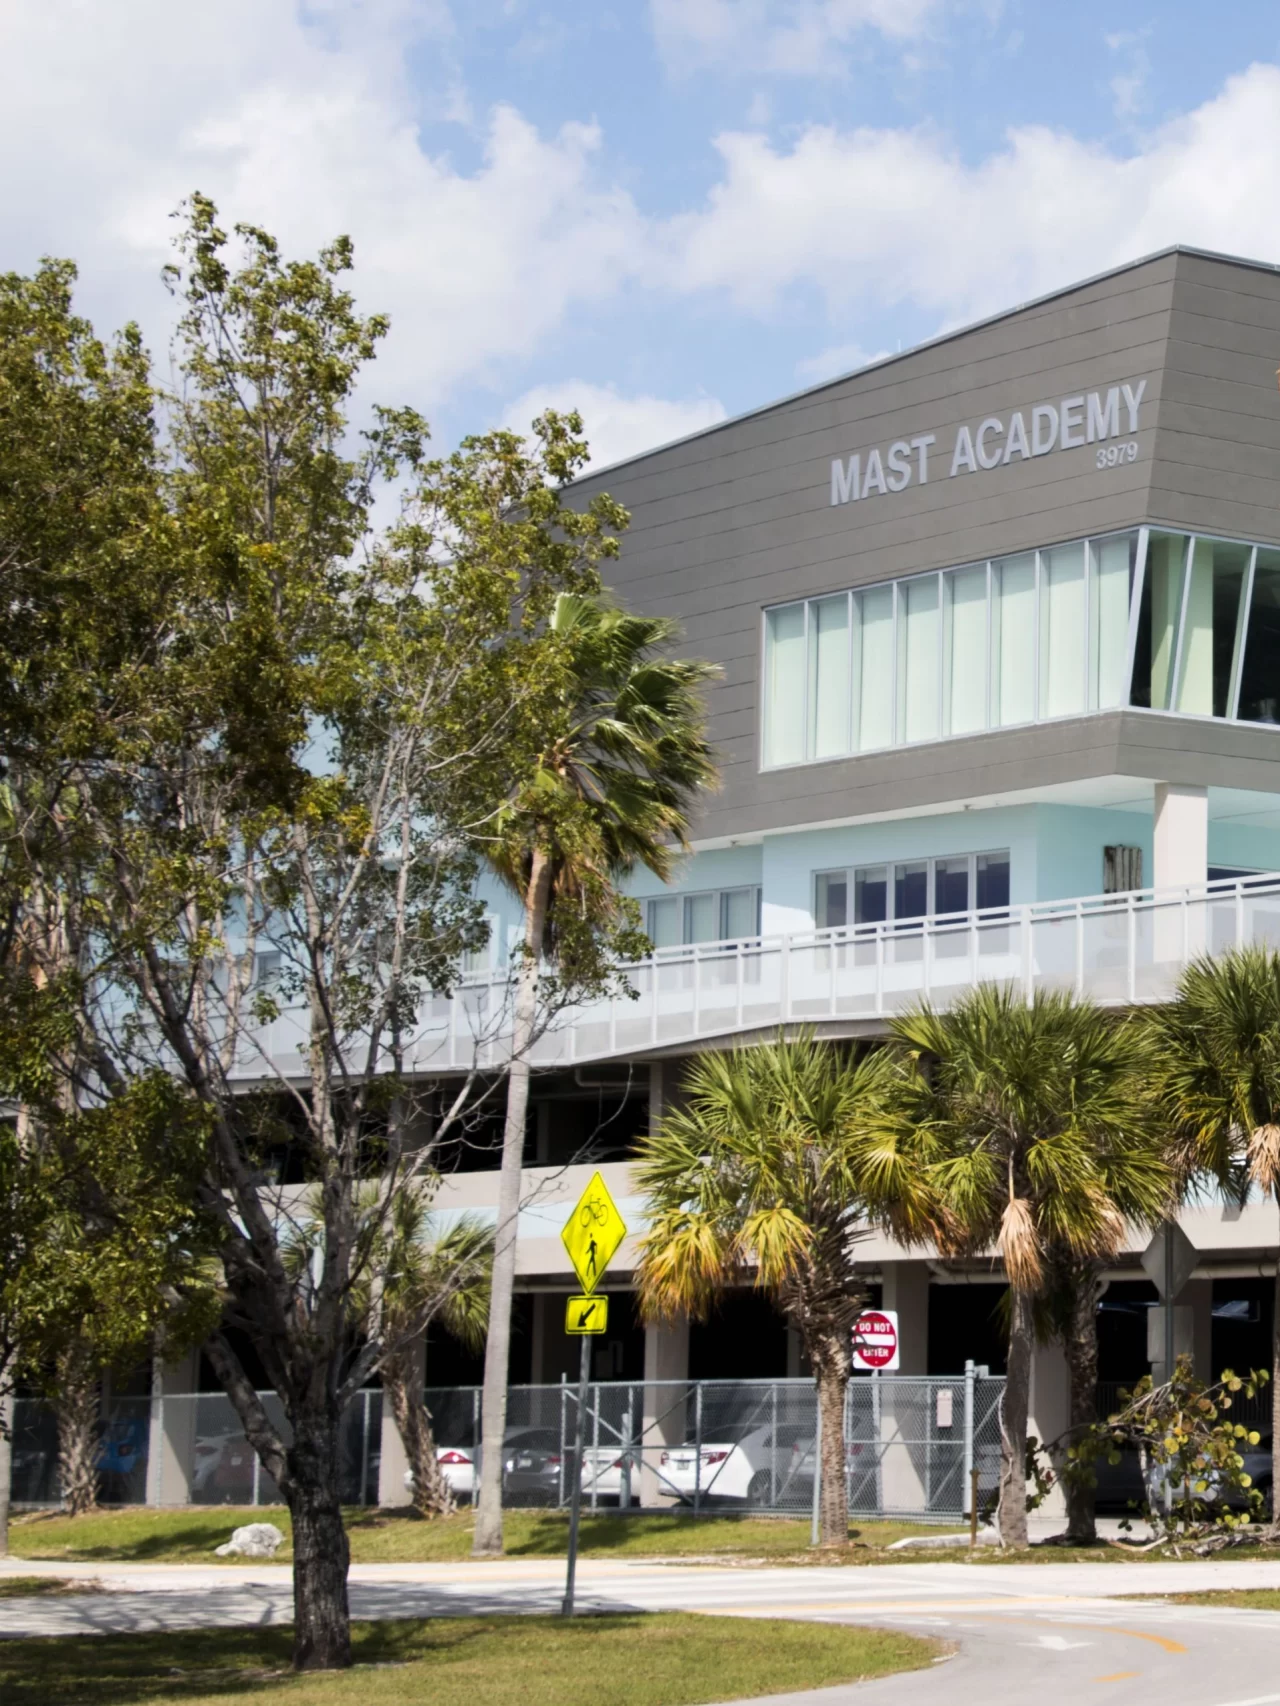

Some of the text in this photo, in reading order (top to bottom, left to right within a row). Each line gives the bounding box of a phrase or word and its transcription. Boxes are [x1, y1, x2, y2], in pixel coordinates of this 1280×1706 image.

[830, 379, 1148, 507] MAST ACADEMY
[1096, 441, 1139, 469] 3979
[859, 1322, 890, 1333] DO NOT
